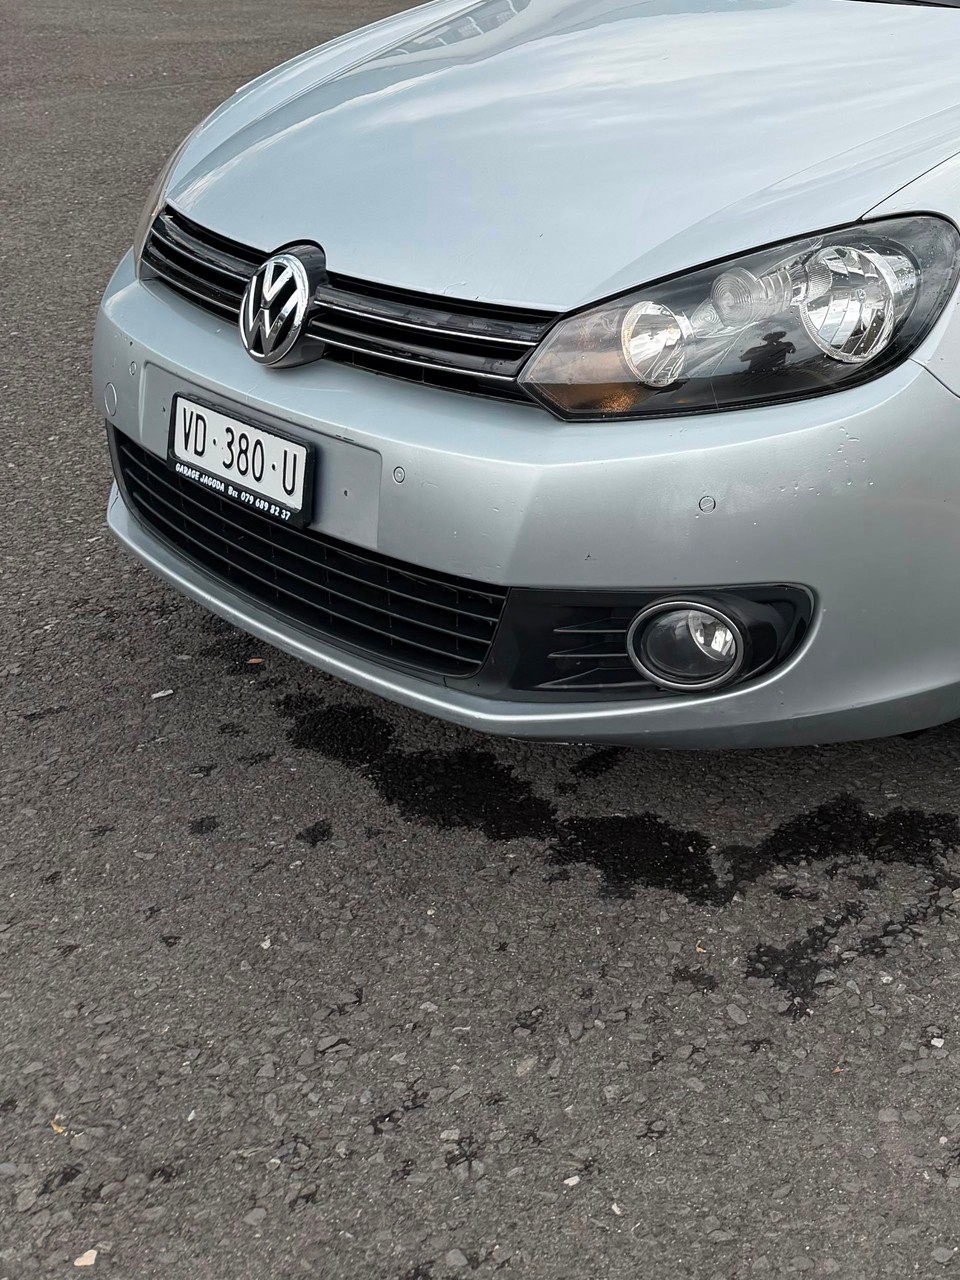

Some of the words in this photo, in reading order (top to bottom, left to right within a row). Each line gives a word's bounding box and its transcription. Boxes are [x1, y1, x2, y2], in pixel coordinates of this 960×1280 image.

[175, 463, 200, 481] GARAGE
[200, 474, 225, 492] JAGODA
[241, 491, 254, 505] 079
[255, 498, 269, 511] 689
[281, 509, 291, 521] 37
